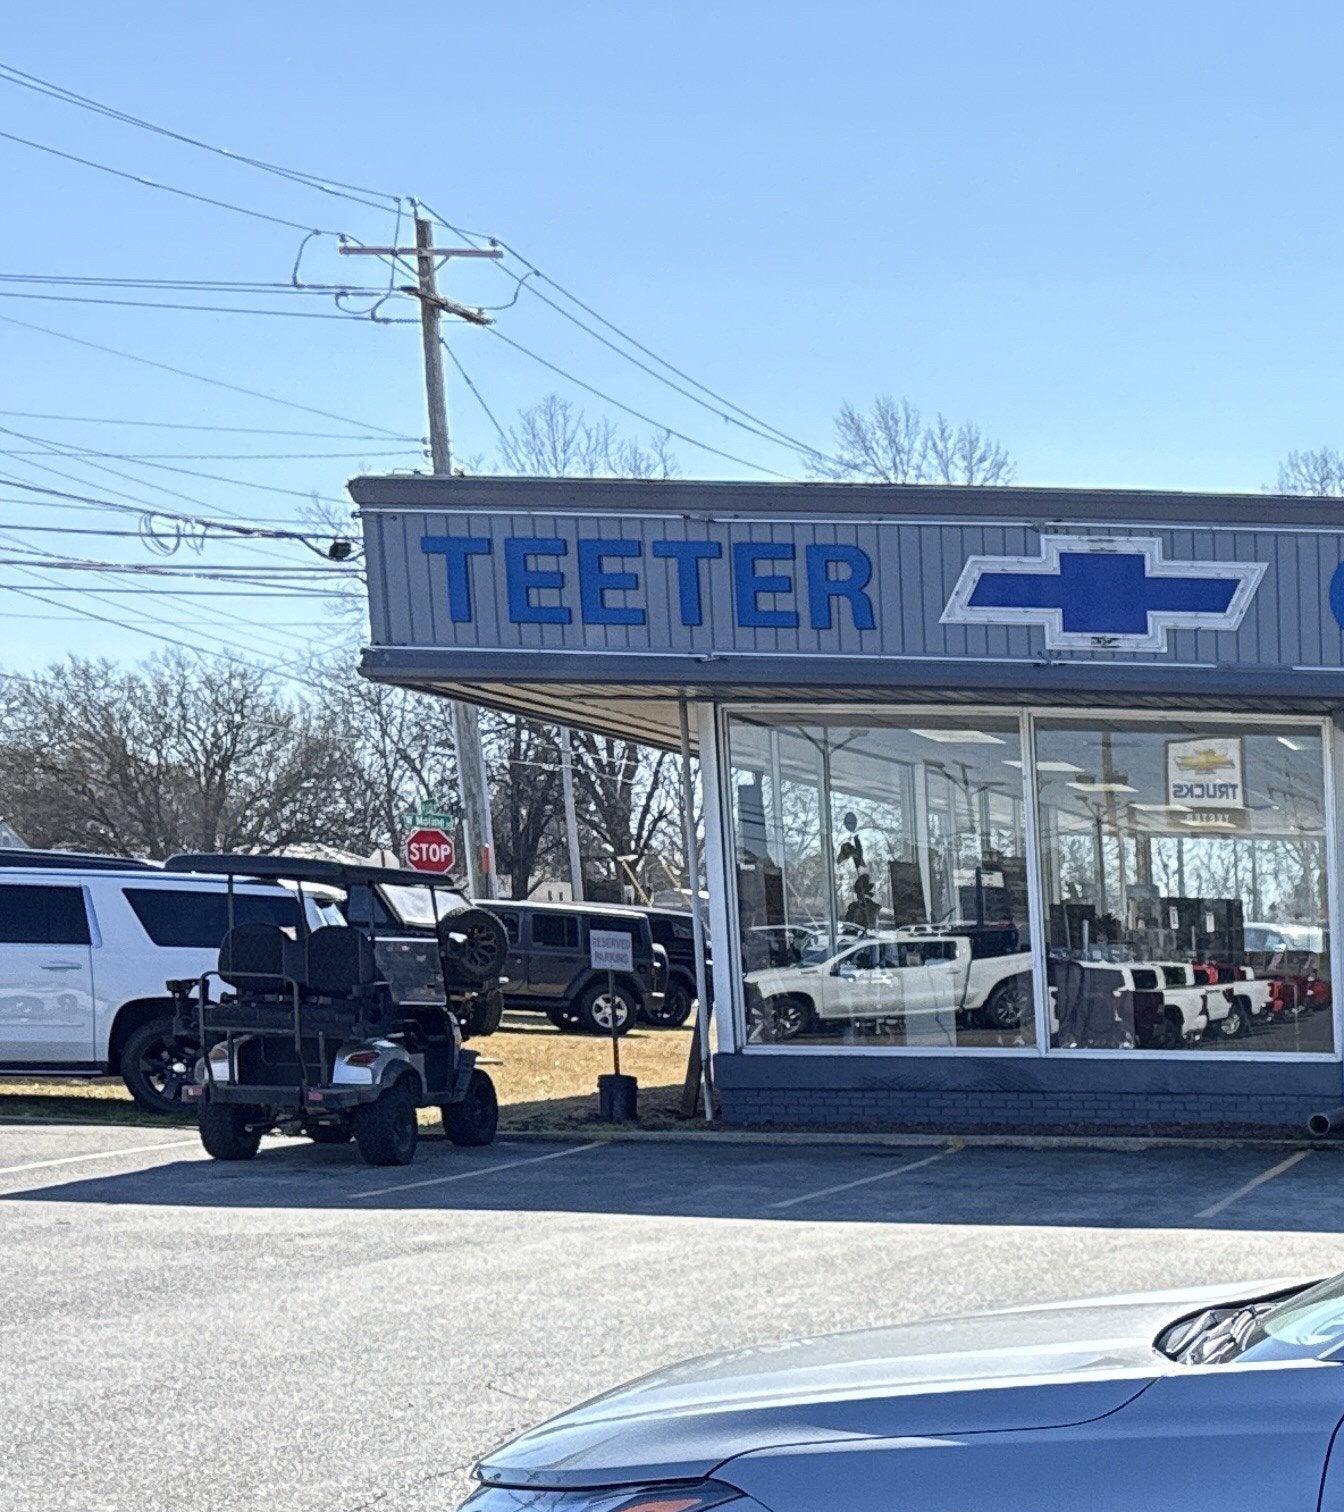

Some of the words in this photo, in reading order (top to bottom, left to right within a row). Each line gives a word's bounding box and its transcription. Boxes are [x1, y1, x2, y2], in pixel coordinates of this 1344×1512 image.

[421, 534, 876, 631] TEETER
[410, 843, 451, 862] STOP
[592, 936, 631, 950] RESERVED
